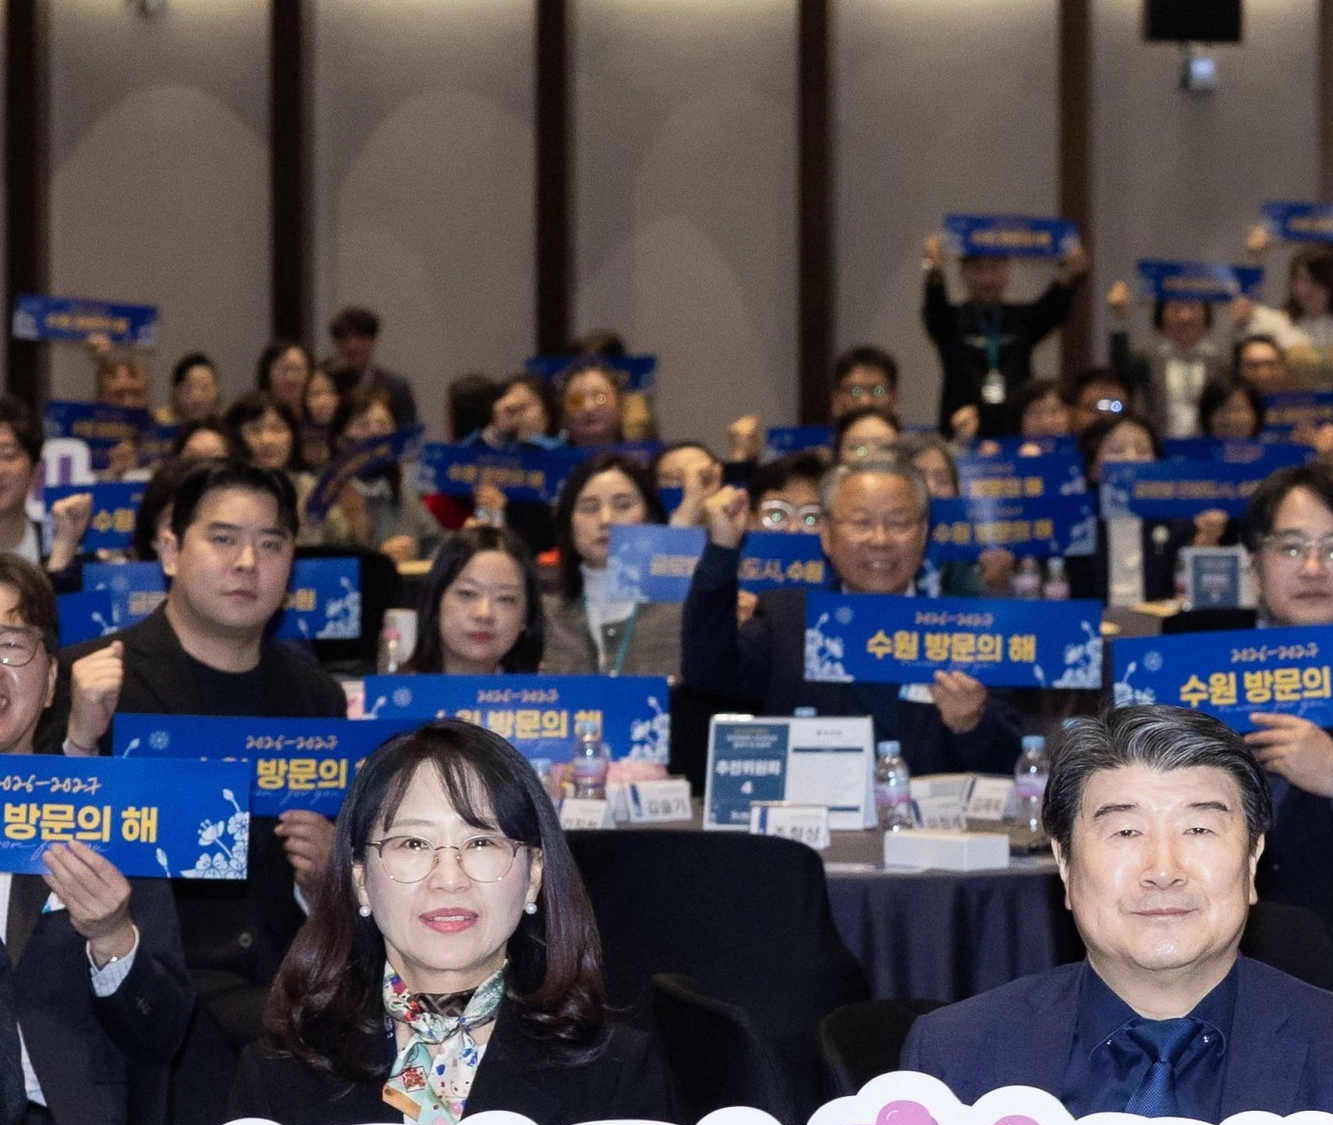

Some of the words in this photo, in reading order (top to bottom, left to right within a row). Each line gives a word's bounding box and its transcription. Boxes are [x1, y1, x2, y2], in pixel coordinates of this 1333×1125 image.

[867, 629, 919, 661] 수원
[924, 632, 1003, 664] 방문의
[1008, 634, 1038, 664] 해
[1180, 673, 1238, 708] 수원
[1243, 665, 1332, 704] 방문의
[487, 709, 568, 740] 방문의
[256, 757, 349, 791] 방문의
[4, 802, 112, 843] 방문의
[121, 805, 159, 844] 해
